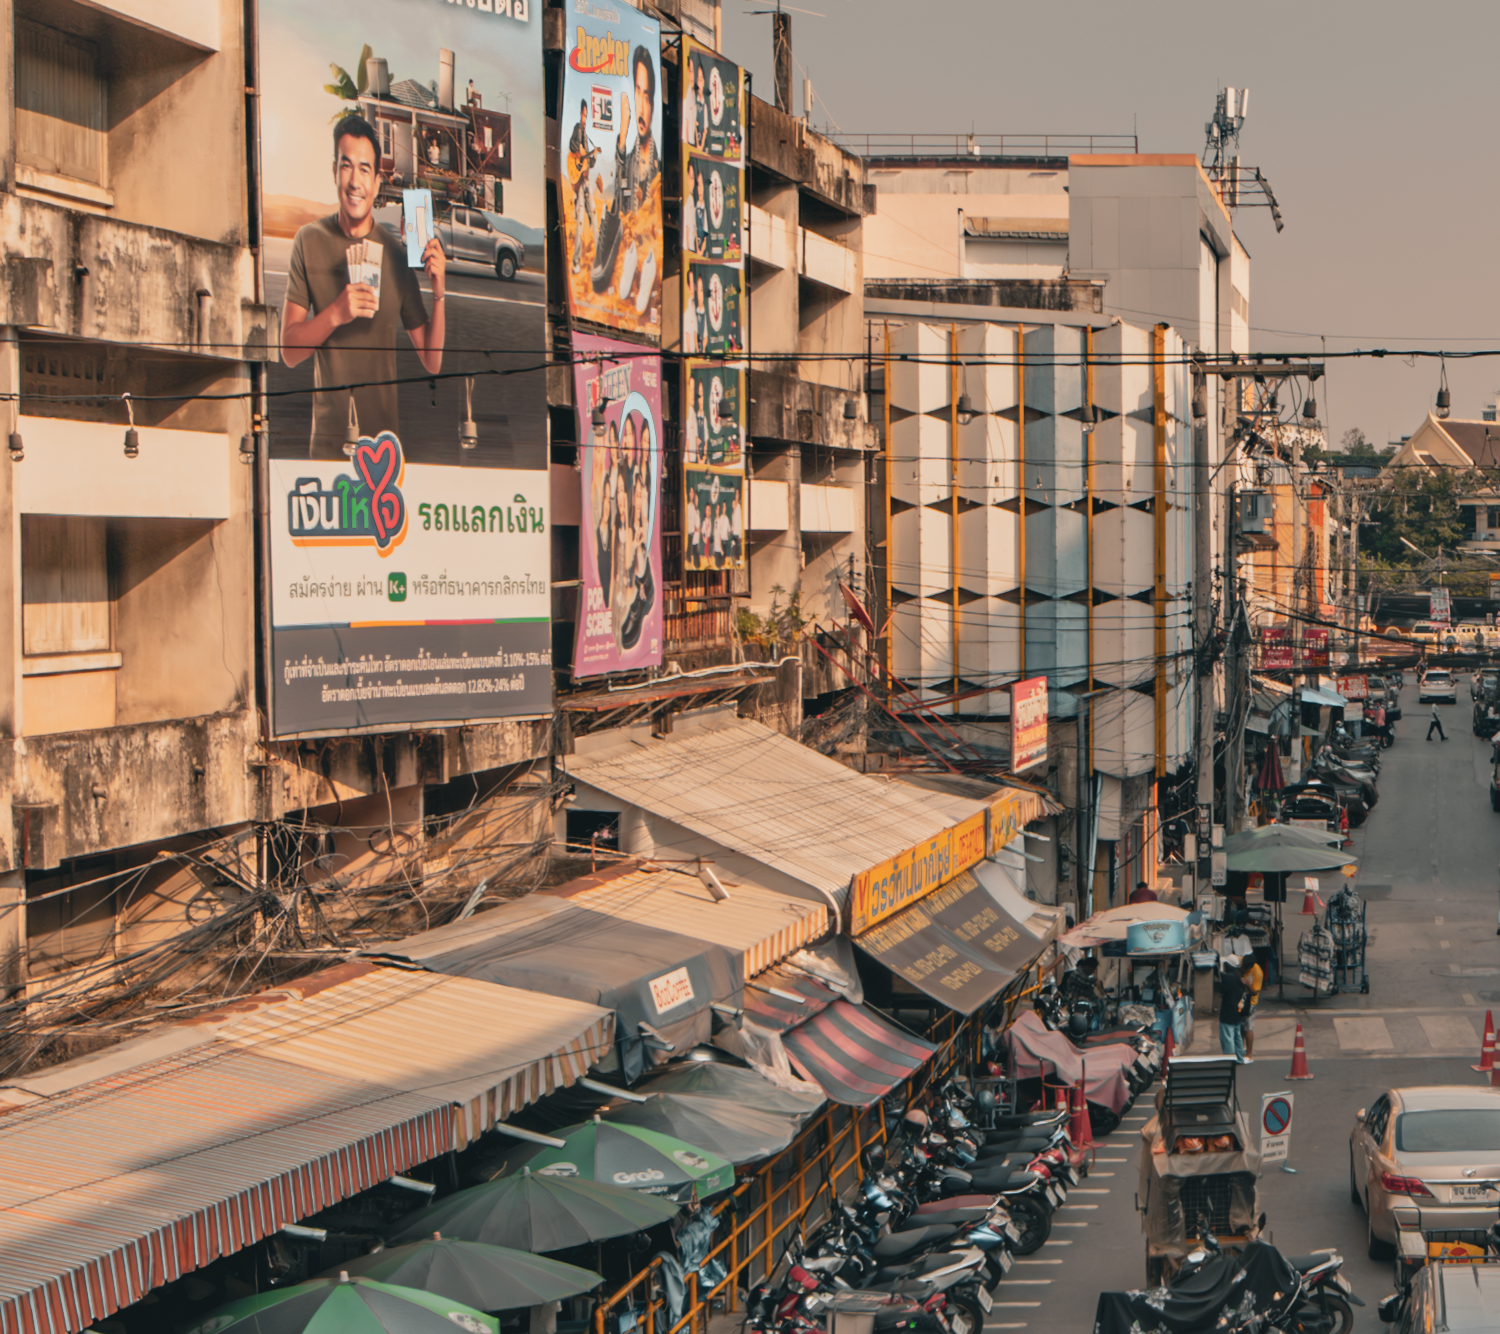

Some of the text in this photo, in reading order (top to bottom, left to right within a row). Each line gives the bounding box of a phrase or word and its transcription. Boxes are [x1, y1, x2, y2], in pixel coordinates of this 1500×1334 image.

[577, 26, 629, 77] Breaker
[419, 493, 545, 534] รถแลกเงิน
[289, 575, 352, 598] สมัครง่าย
[357, 575, 384, 596] ผ่าน
[412, 568, 546, 596] หรือที่ธนาคารกสิกรไทย
[587, 587, 604, 612] POP
[586, 610, 613, 637] SCENE
[467, 677, 510, 694] 12.82%-24%
[613, 1168, 665, 1183] Grab
